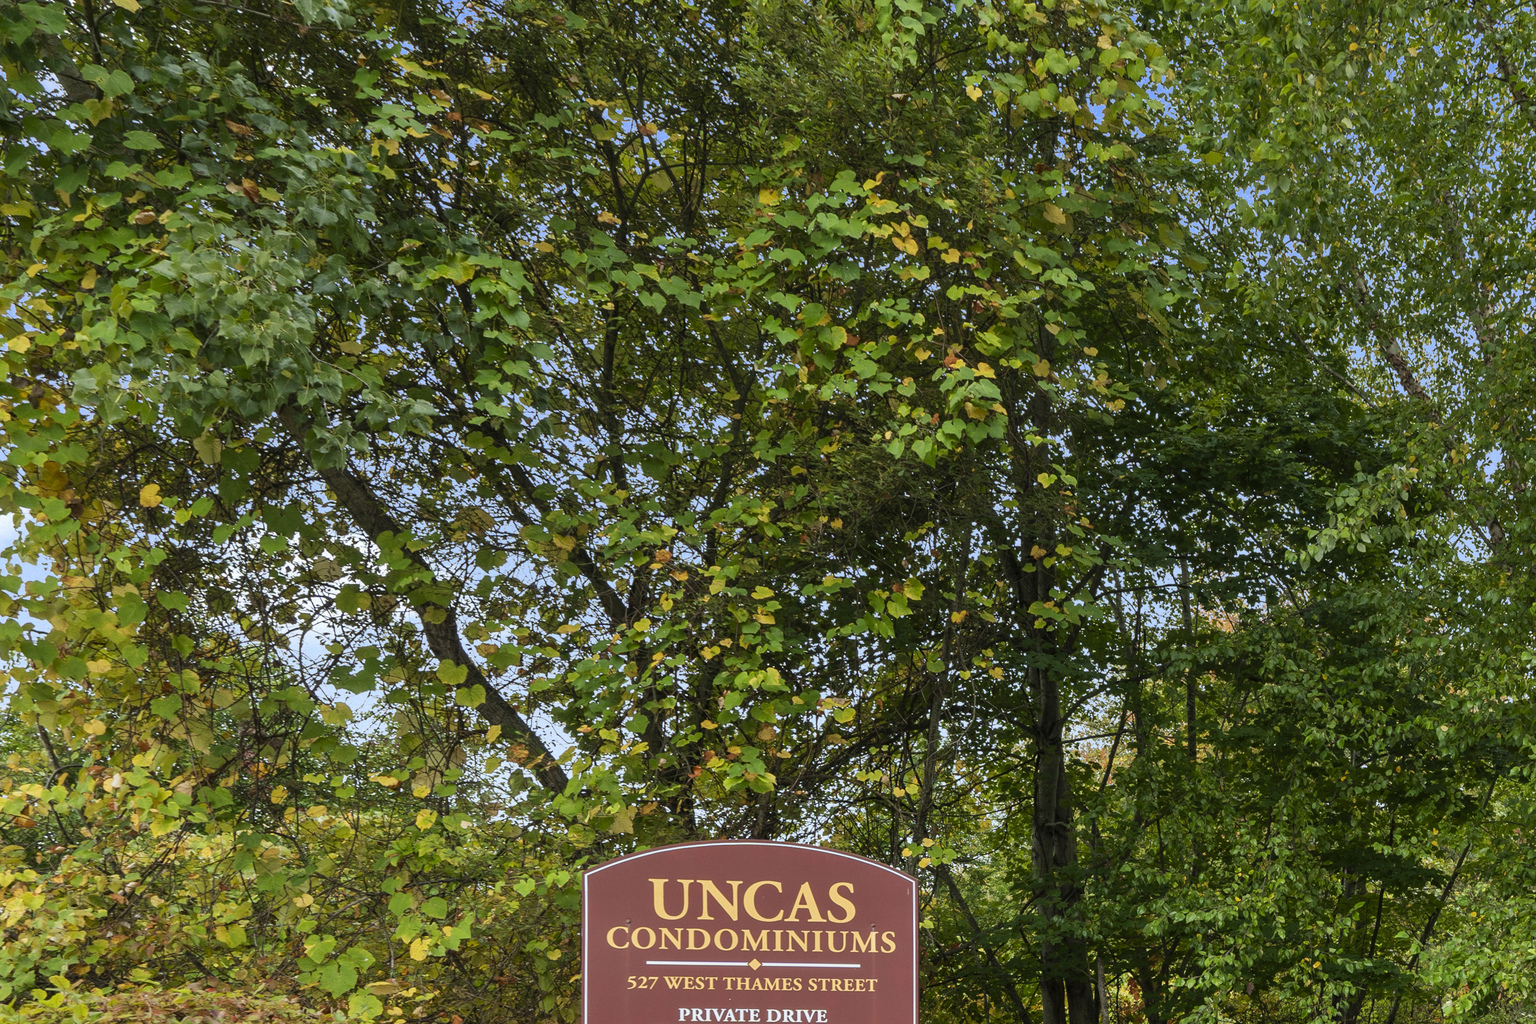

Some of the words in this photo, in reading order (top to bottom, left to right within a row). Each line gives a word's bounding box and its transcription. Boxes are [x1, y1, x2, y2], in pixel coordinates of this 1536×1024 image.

[648, 878, 856, 924] UNCAS
[606, 926, 896, 954] CONDOMINIUMS
[627, 976, 658, 990] 527
[663, 976, 718, 991] WEST
[723, 977, 803, 992] THAMES
[808, 978, 878, 993] STREET
[678, 1007, 761, 1023] PRIVATE
[766, 1009, 828, 1023] DRIVE
